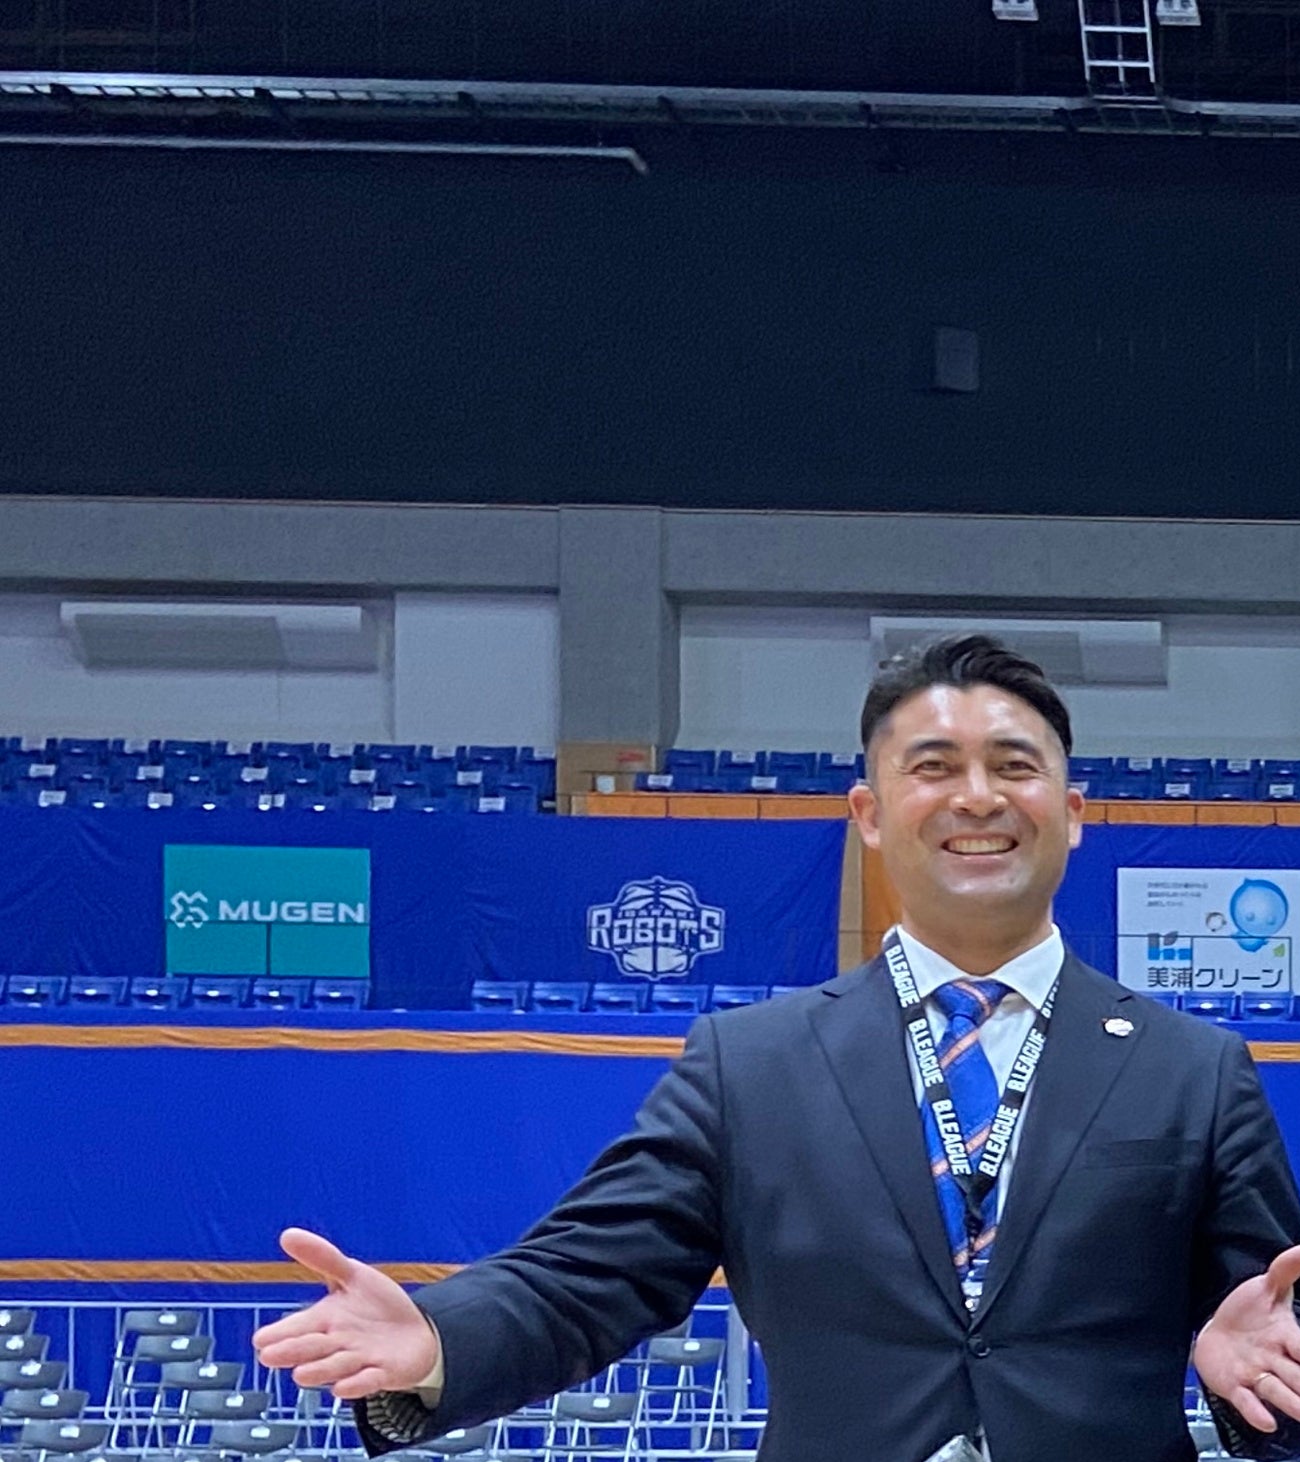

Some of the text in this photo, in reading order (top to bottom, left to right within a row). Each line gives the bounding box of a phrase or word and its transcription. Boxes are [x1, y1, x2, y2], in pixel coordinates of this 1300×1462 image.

[218, 900, 365, 923] MUGEN
[590, 908, 721, 950] ROBOTS
[1147, 966, 1284, 989] 美浦クリーン
